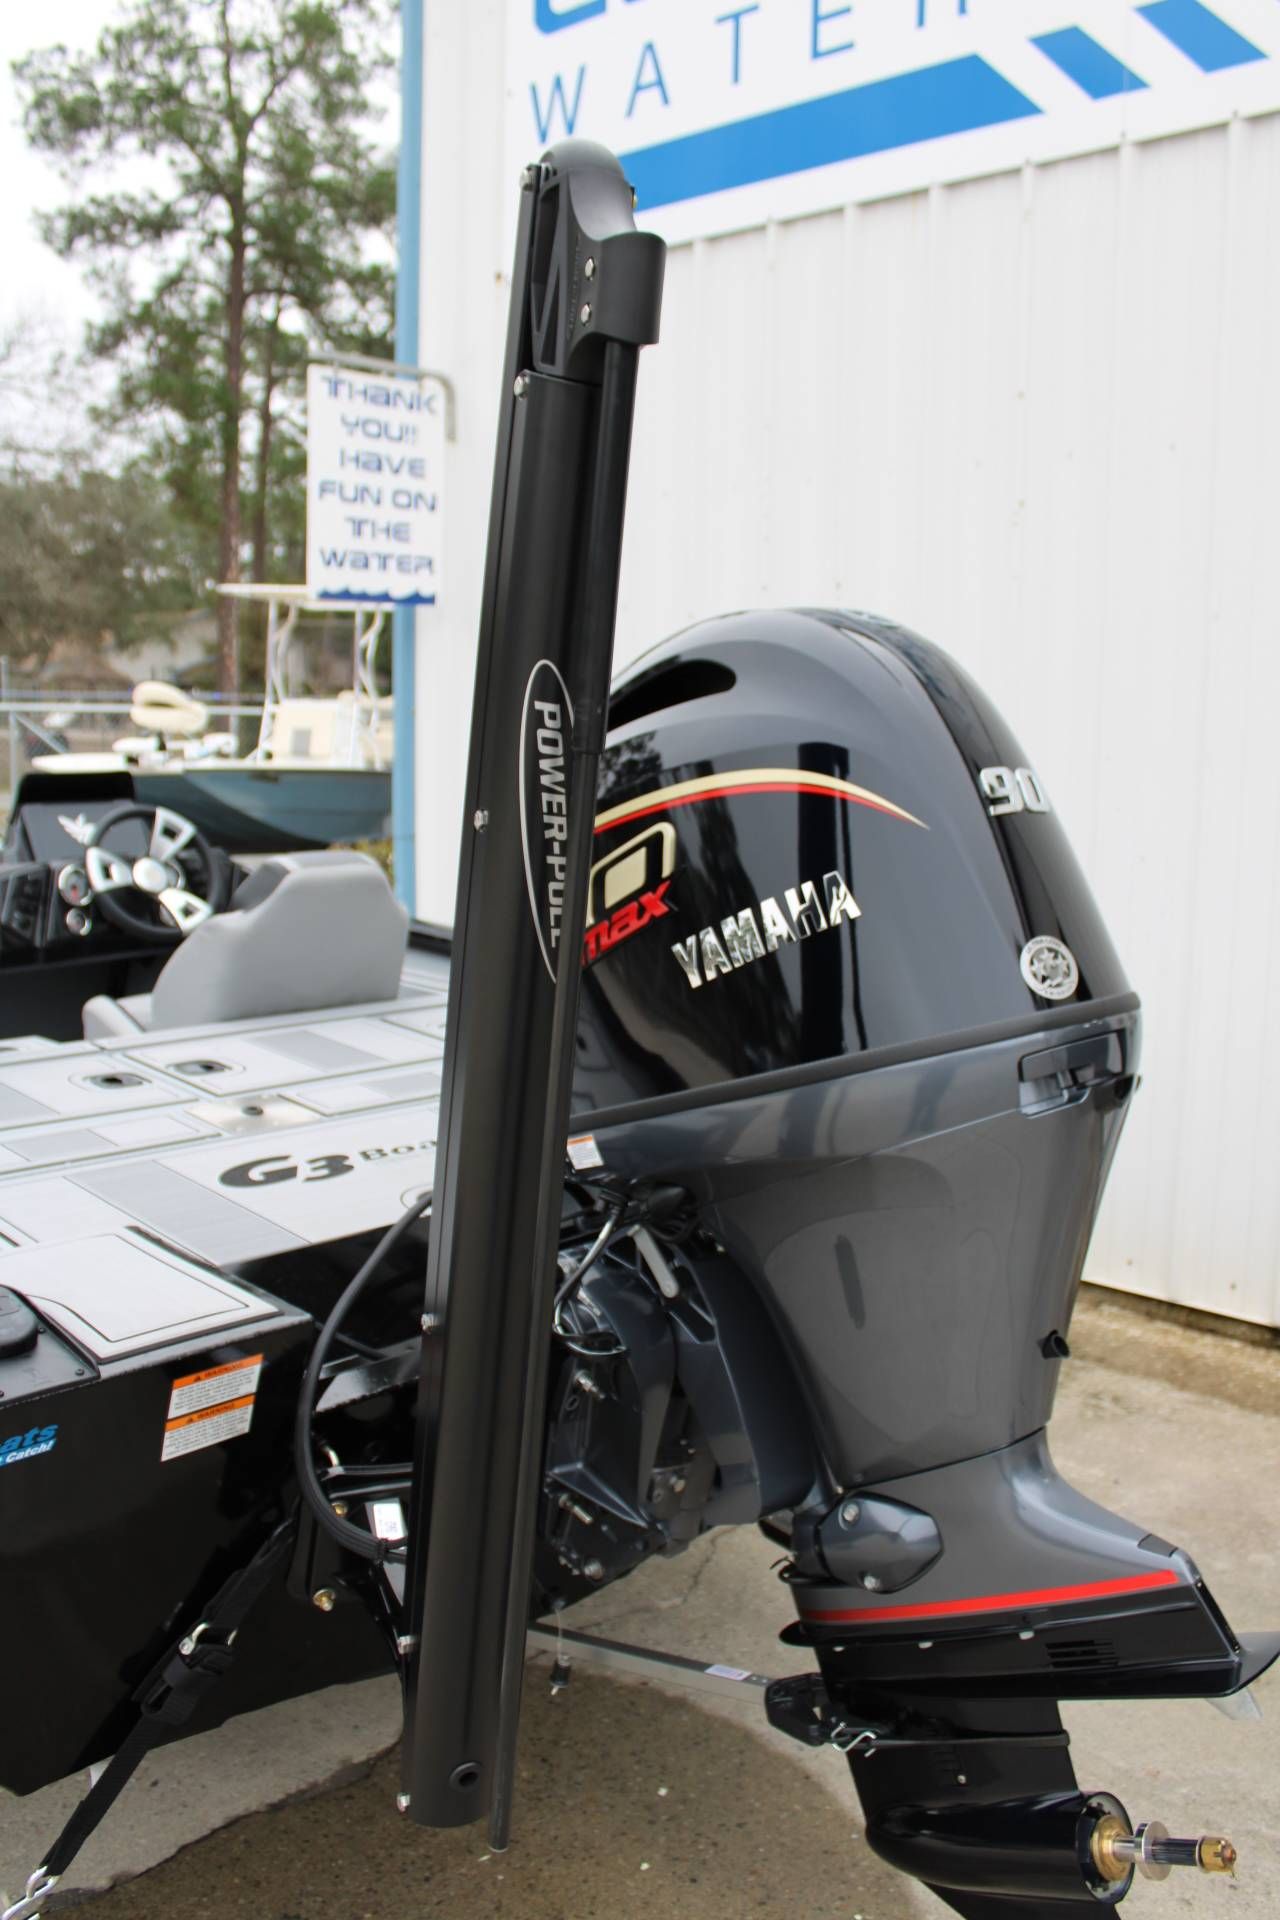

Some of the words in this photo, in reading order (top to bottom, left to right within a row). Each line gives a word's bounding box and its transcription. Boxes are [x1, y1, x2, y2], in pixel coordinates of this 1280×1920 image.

[341, 415, 417, 444] YOU!!
[318, 480, 383, 507] FUN
[391, 488, 437, 513] ON
[345, 516, 411, 543] THE
[979, 766, 1049, 817] 90
[671, 870, 862, 989] YAMAHA
[219, 1154, 355, 1188] G3
[0, 1424, 59, 1453] ats
